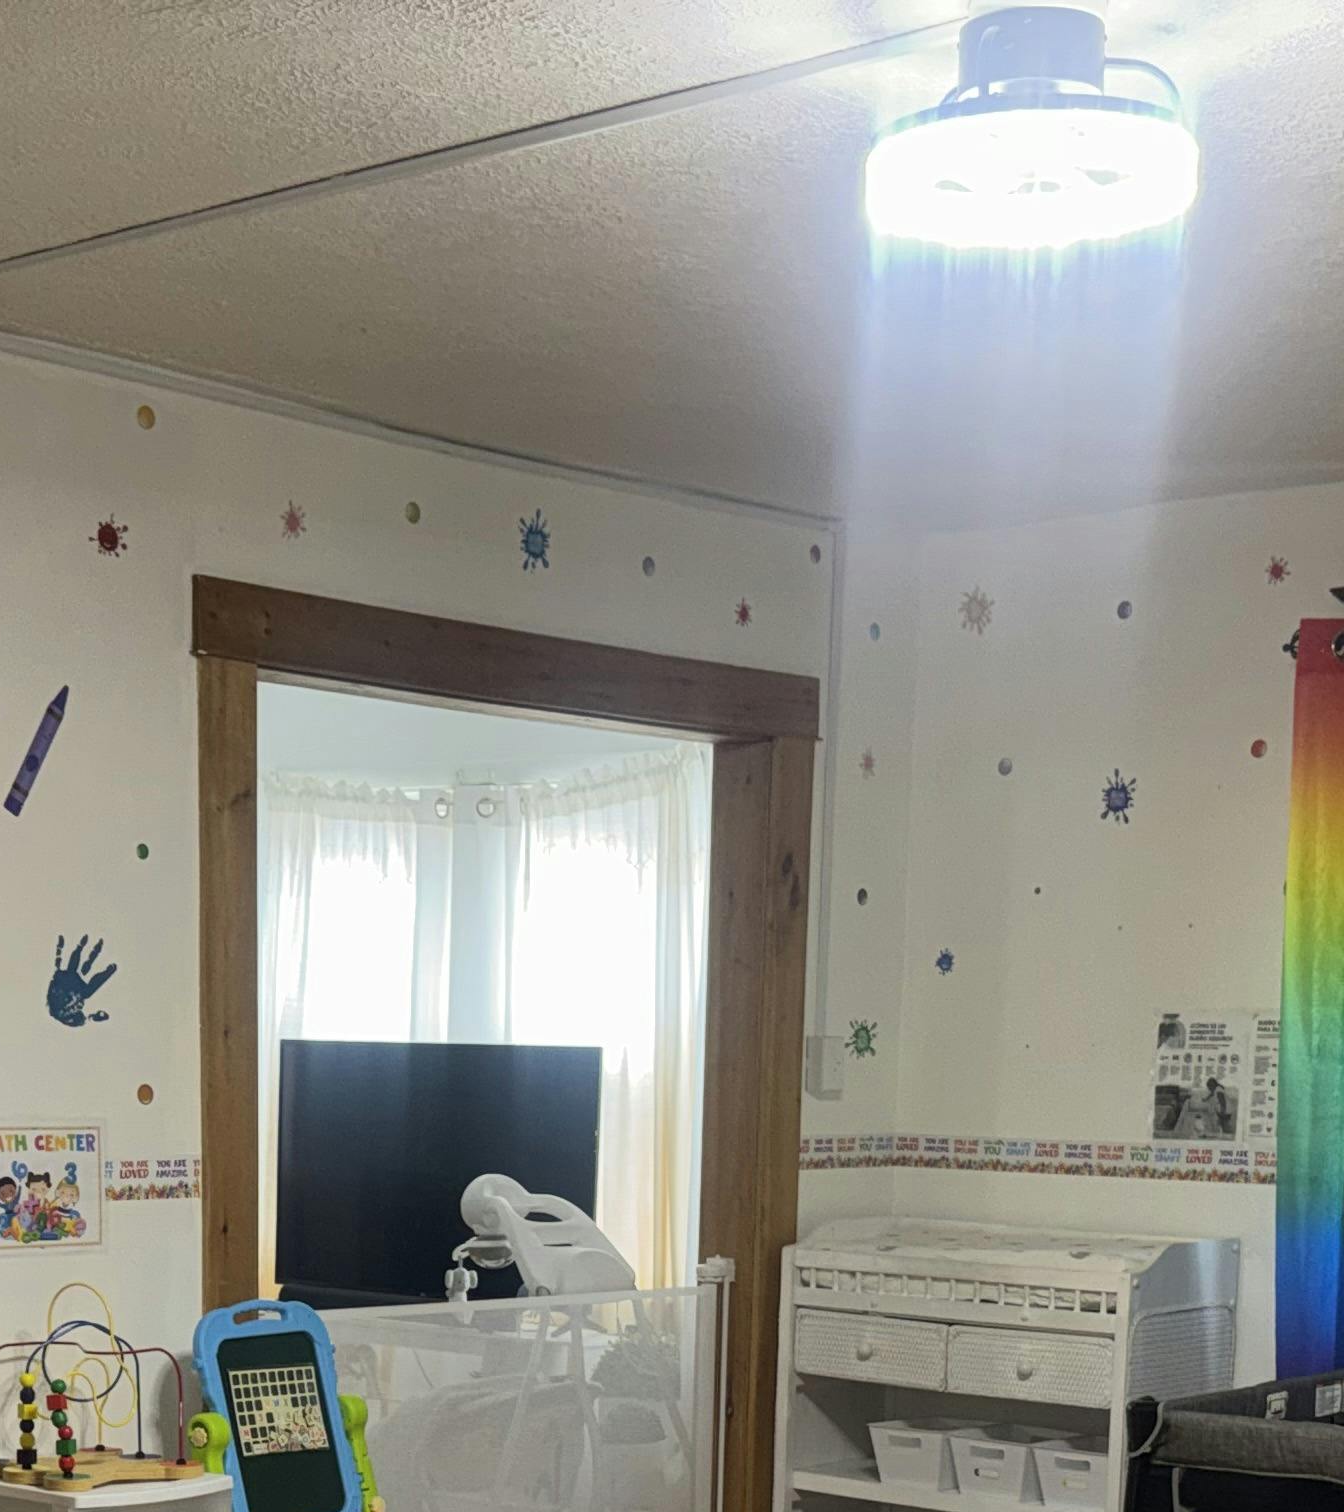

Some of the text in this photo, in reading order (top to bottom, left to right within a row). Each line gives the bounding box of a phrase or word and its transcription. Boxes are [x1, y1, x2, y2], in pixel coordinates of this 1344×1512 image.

[34, 1133, 95, 1152] CENTER
[984, 1146, 1001, 1155] YOU
[1130, 1152, 1149, 1161] YOU
[156, 1160, 170, 1168] YOU
[64, 1162, 77, 1185] 3
[120, 1169, 149, 1179] LOVED
